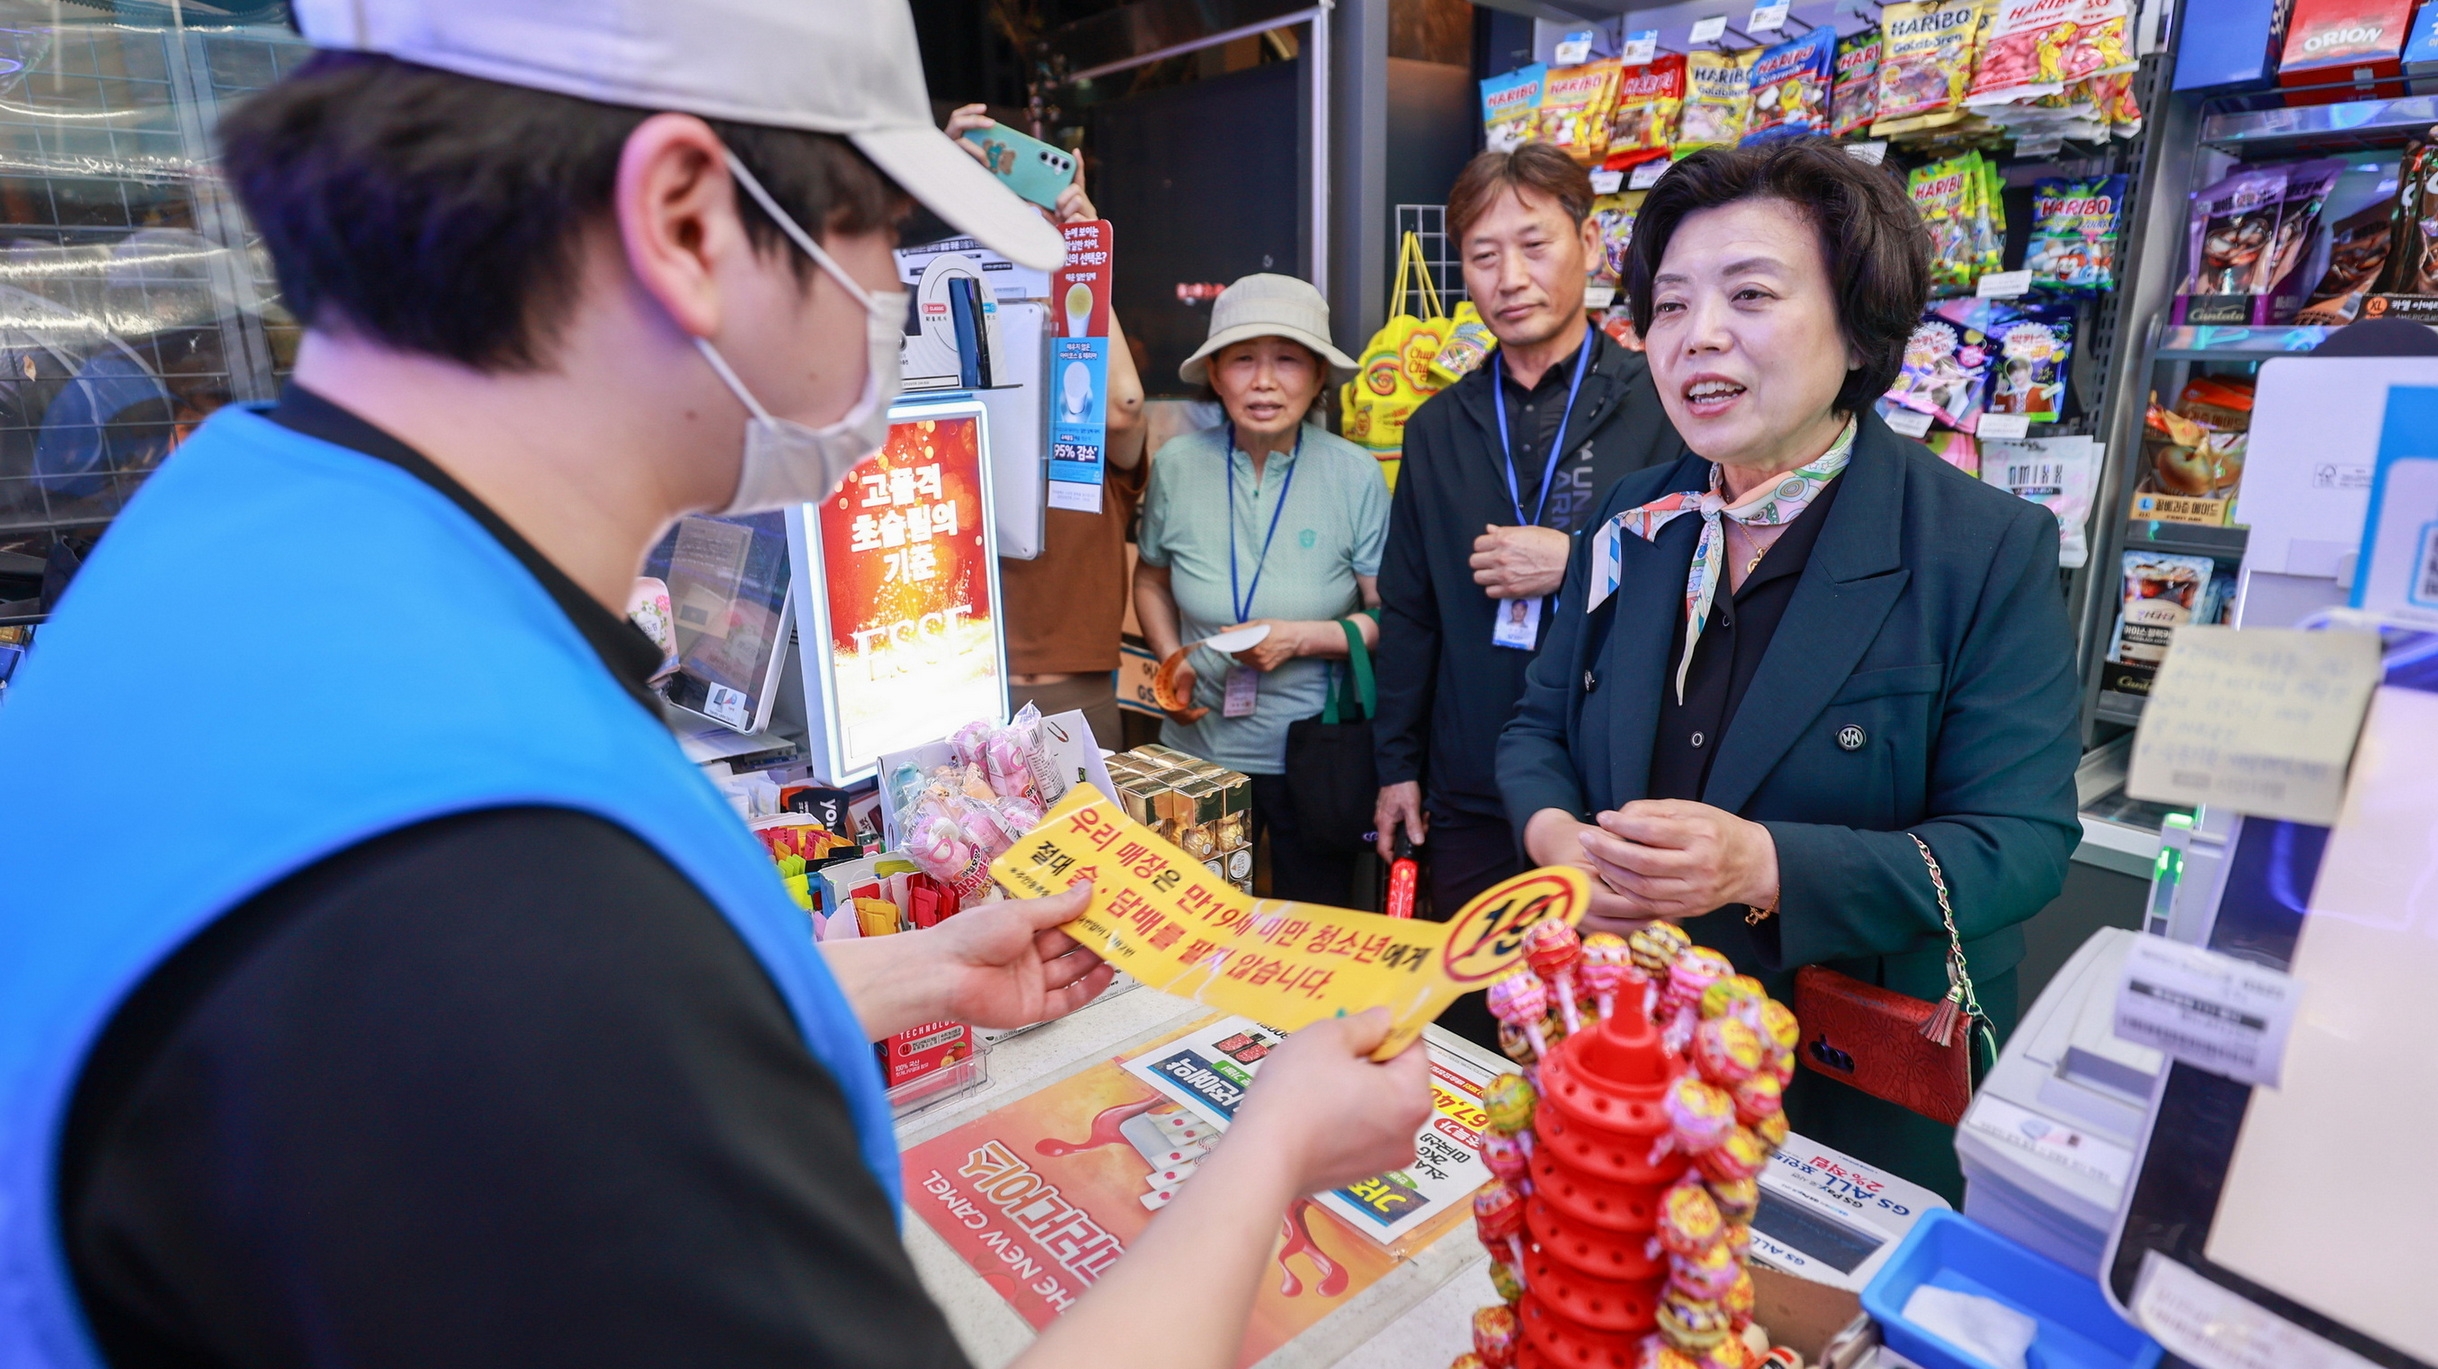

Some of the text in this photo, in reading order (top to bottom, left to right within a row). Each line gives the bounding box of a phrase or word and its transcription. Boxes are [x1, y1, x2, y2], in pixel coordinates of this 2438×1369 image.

[1891, 8, 1972, 37] HARIBO
[2303, 27, 2383, 52] ORION
[1838, 41, 1882, 72] HARI
[1487, 81, 1539, 107] HARIBO
[1550, 72, 1603, 95] HARIBO
[1914, 172, 1964, 201] HARIBO
[2041, 196, 2112, 217] HARIBO
[2371, 298, 2382, 310] XL
[1054, 444, 1076, 460] 95%
[860, 462, 944, 508] 고품격
[851, 500, 959, 553] 초슬림의
[883, 547, 936, 586] 기준
[1069, 807, 1434, 973] 우리 매장은 만19세 미만 청소년에게
[1030, 840, 1076, 877] 절대
[1177, 938, 1238, 972] 팔지
[1226, 953, 1336, 1000] 않습니다.
[1438, 1119, 1481, 1148] 초특가
[1412, 1159, 1449, 1182] 소LA
[1416, 1147, 1448, 1167] 2KG
[1808, 1155, 1848, 1178] 적립
[1823, 1172, 1875, 1201] ALL
[1850, 1173, 1885, 1193] 2%
[958, 1139, 1125, 1289] 파라다이스
[1843, 1195, 1863, 1208] GS
[1877, 1198, 1910, 1216] GS
[922, 1168, 1076, 1316] HE NEW CAMEL
[1752, 1235, 1805, 1266] GS ALL
